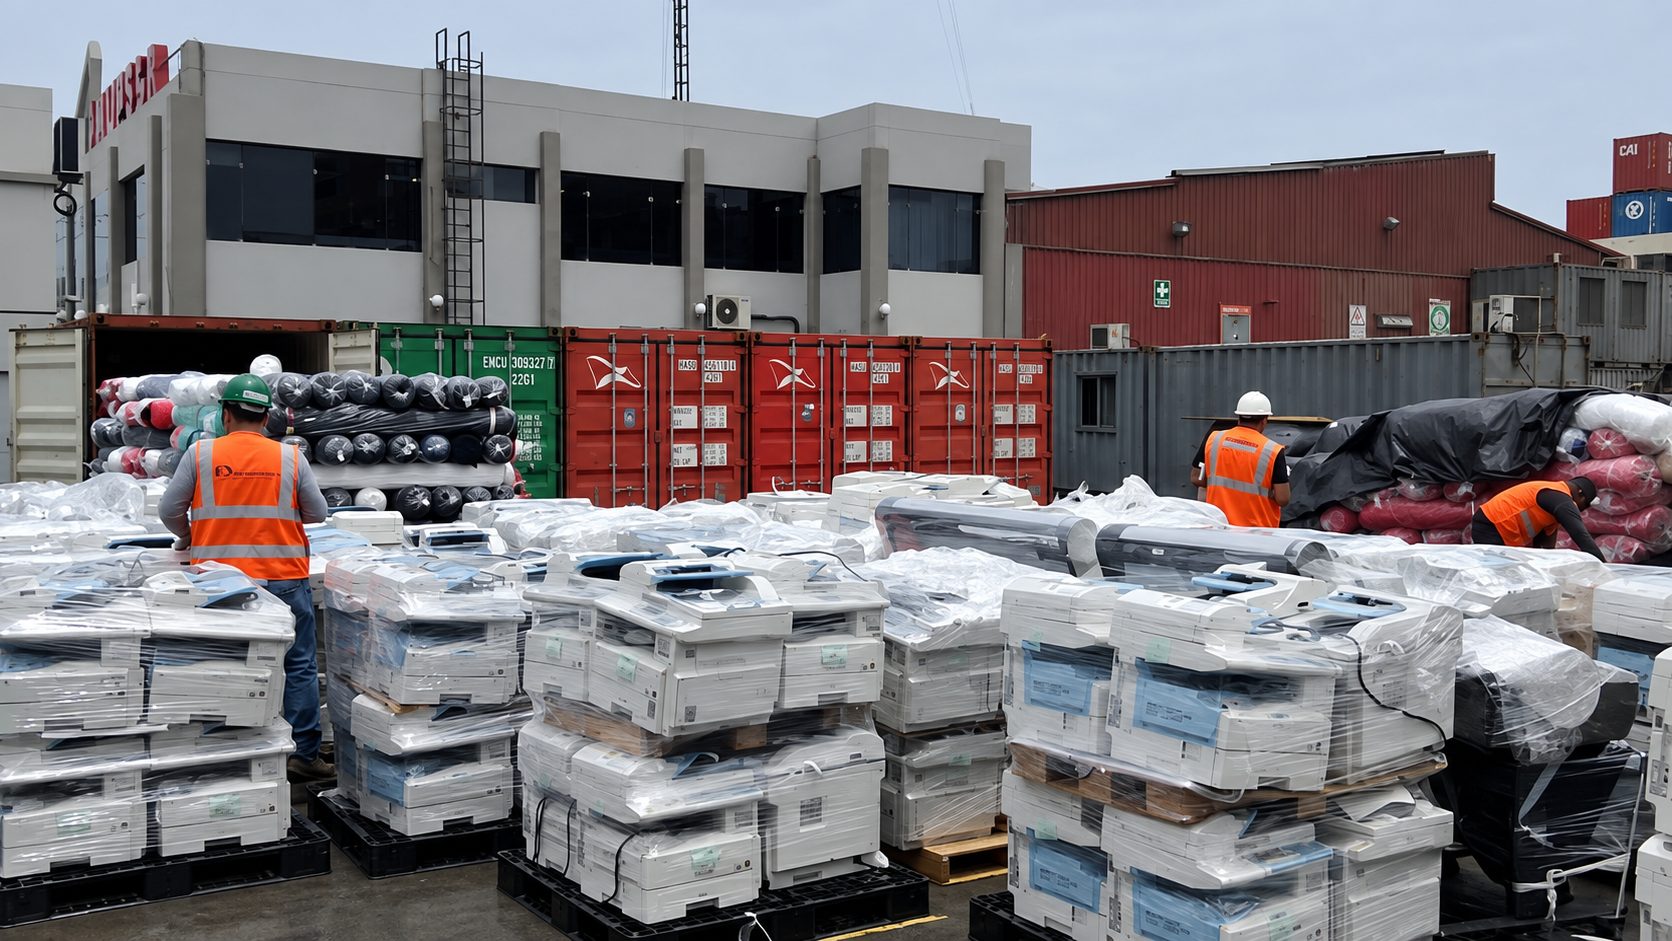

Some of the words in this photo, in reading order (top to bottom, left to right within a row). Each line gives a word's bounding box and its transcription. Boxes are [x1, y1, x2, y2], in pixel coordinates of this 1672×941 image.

[1620, 144, 1638, 157] CAI
[483, 356, 507, 369] EMCU
[511, 356, 545, 369] 309327
[512, 373, 534, 385] 22G1
